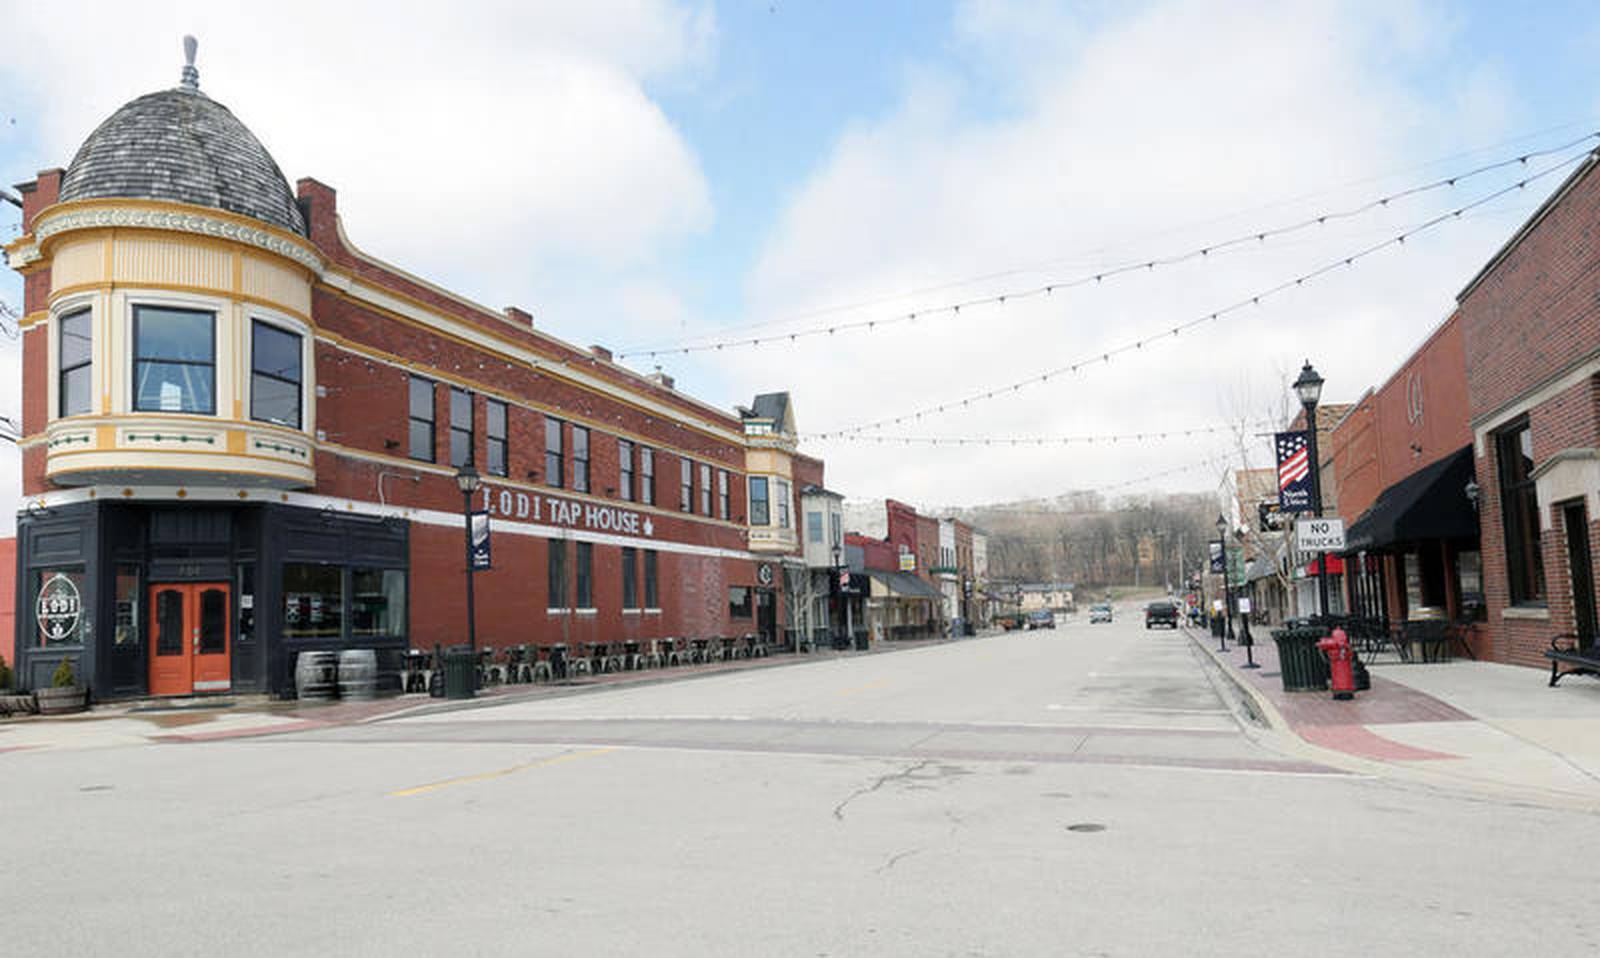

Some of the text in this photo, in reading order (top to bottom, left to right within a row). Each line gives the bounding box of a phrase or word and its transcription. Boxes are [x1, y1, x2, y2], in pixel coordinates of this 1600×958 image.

[482, 487, 639, 533] LODI TAP HOUSE
[1311, 523, 1329, 533] NO
[1301, 537, 1343, 547] TRUCKS
[42, 598, 75, 613] LODI
